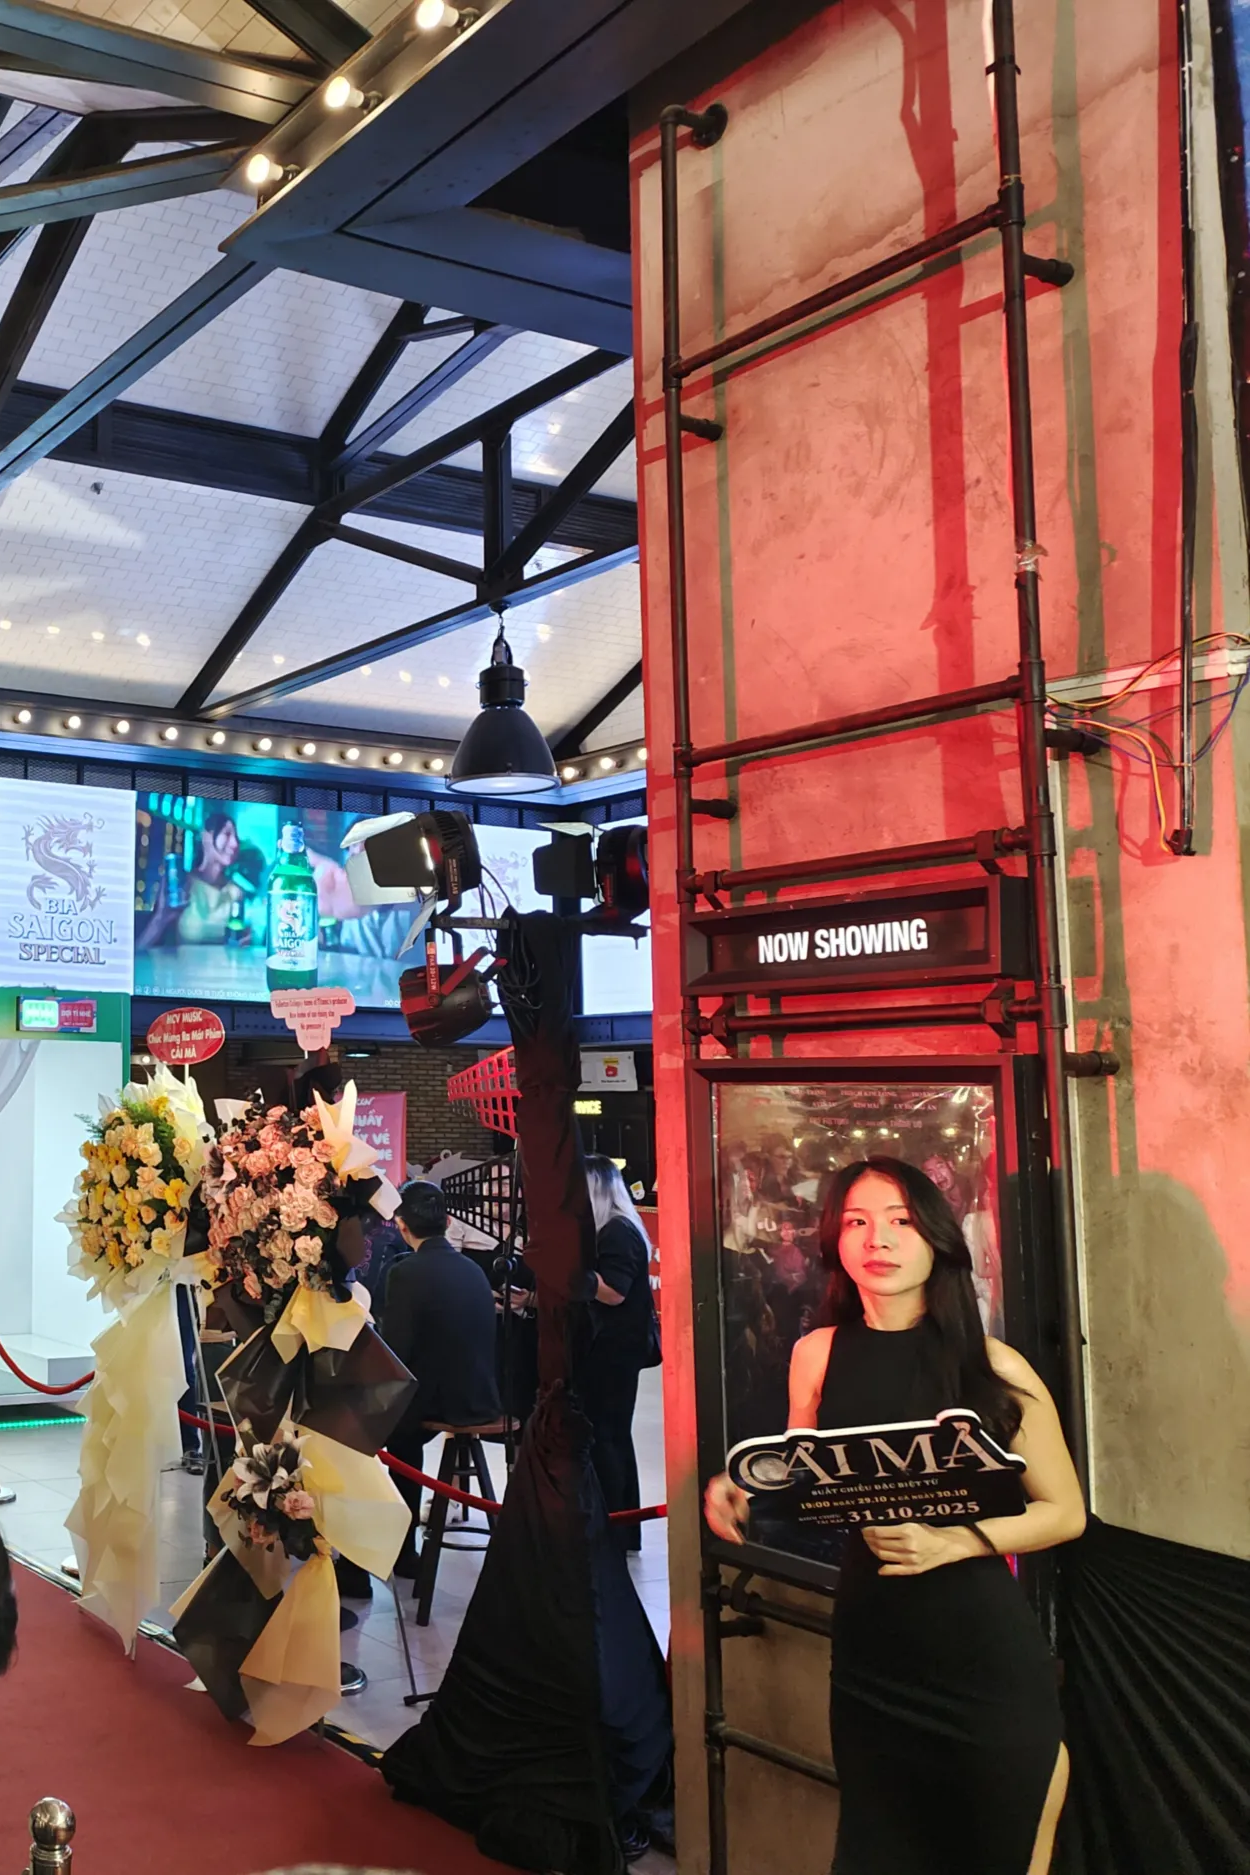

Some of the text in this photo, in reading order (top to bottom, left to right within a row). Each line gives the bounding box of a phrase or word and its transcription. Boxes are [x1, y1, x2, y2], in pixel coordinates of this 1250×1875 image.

[45, 898, 78, 916] BIA
[8, 912, 113, 944] SAIGON
[758, 918, 928, 964] NOW SHOWING
[18, 942, 106, 965] SPECIAL
[182, 1011, 203, 1023] MUSIC
[372, 1128, 391, 1145] VÉ
[800, 1500, 830, 1510] 19:00
[857, 1495, 887, 1504] 29.10
[937, 1488, 968, 1498] 30.10
[848, 1501, 980, 1523] 31.10.2025
